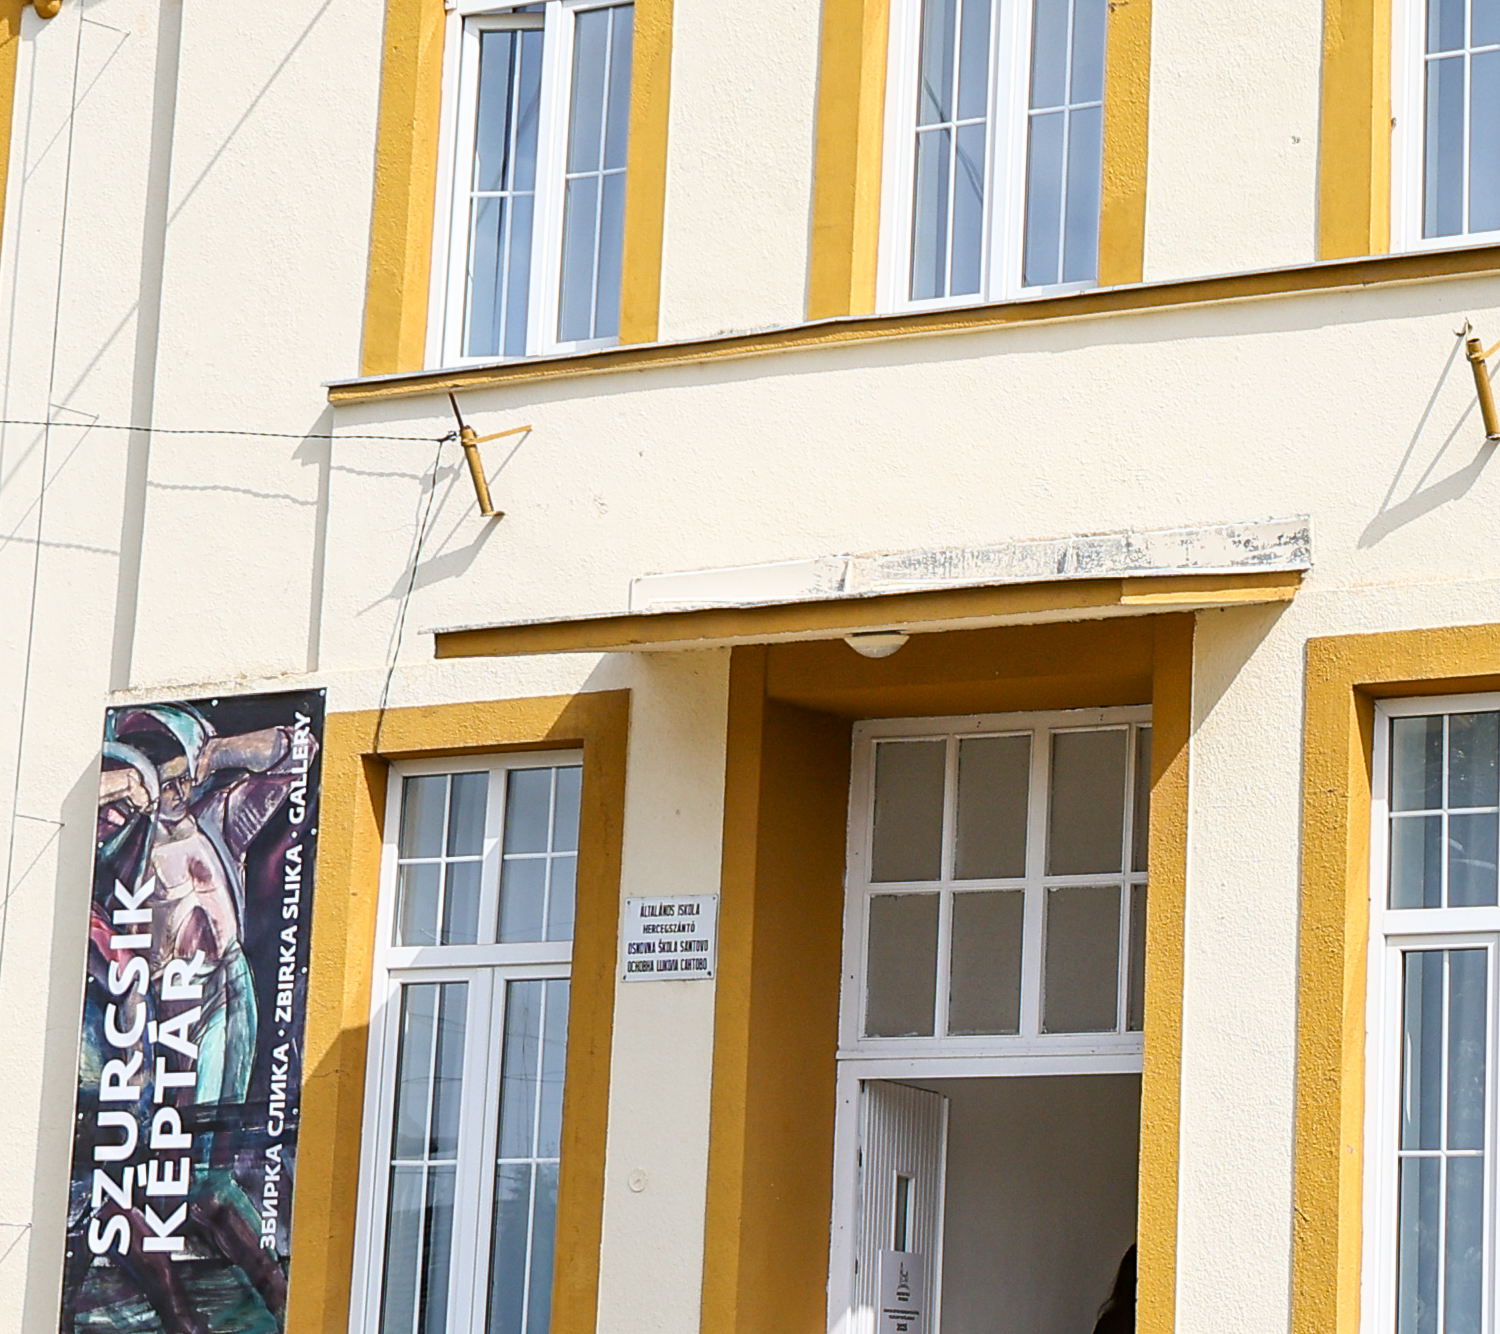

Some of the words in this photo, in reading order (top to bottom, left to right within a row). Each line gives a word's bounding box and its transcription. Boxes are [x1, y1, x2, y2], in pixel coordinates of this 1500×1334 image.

[289, 711, 311, 825] GALLERY
[282, 844, 303, 920] SLIKA
[640, 902, 675, 917] ÁLTALÁNOS
[677, 903, 700, 915] ISKOLA
[643, 921, 695, 934] HERCEGSZÁNTÓ
[275, 925, 297, 1022] ZBIRKA
[88, 875, 156, 1256] SZURCSIK
[137, 949, 205, 1253] KÉPTÁR
[267, 1042, 290, 1137] СЛИКА
[260, 1143, 283, 1250] ЗБИРКА
